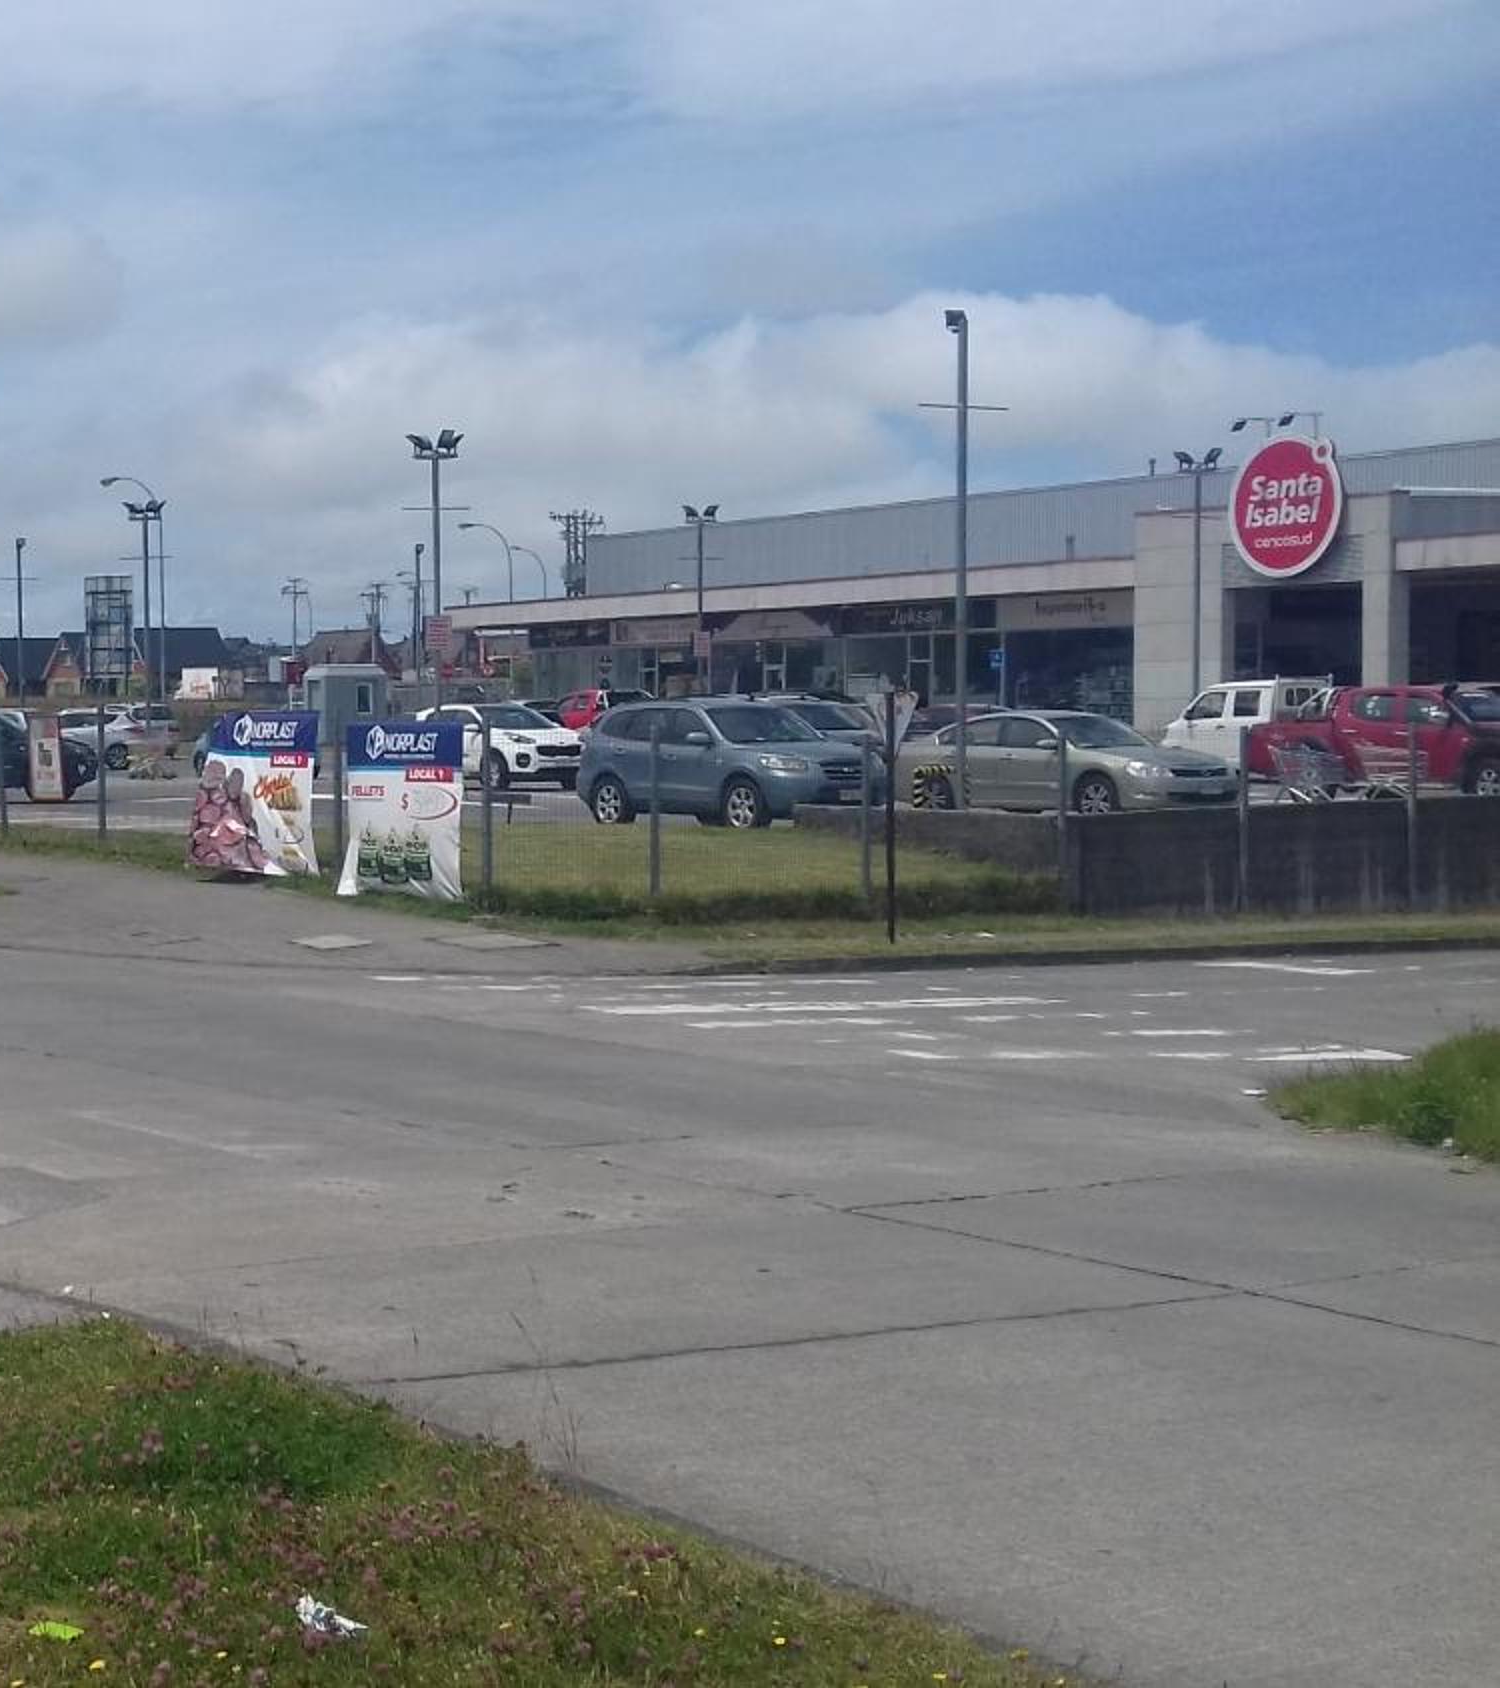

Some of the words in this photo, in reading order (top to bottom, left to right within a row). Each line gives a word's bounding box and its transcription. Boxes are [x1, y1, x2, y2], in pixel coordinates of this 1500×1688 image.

[1249, 473, 1322, 500] Santa
[1245, 496, 1320, 528] Isabel
[1254, 531, 1313, 548] cencosud
[252, 721, 299, 740] NORPLAST
[384, 732, 439, 752] NORPLAST
[273, 755, 296, 765] LOCAL
[408, 767, 436, 779] LOCAL
